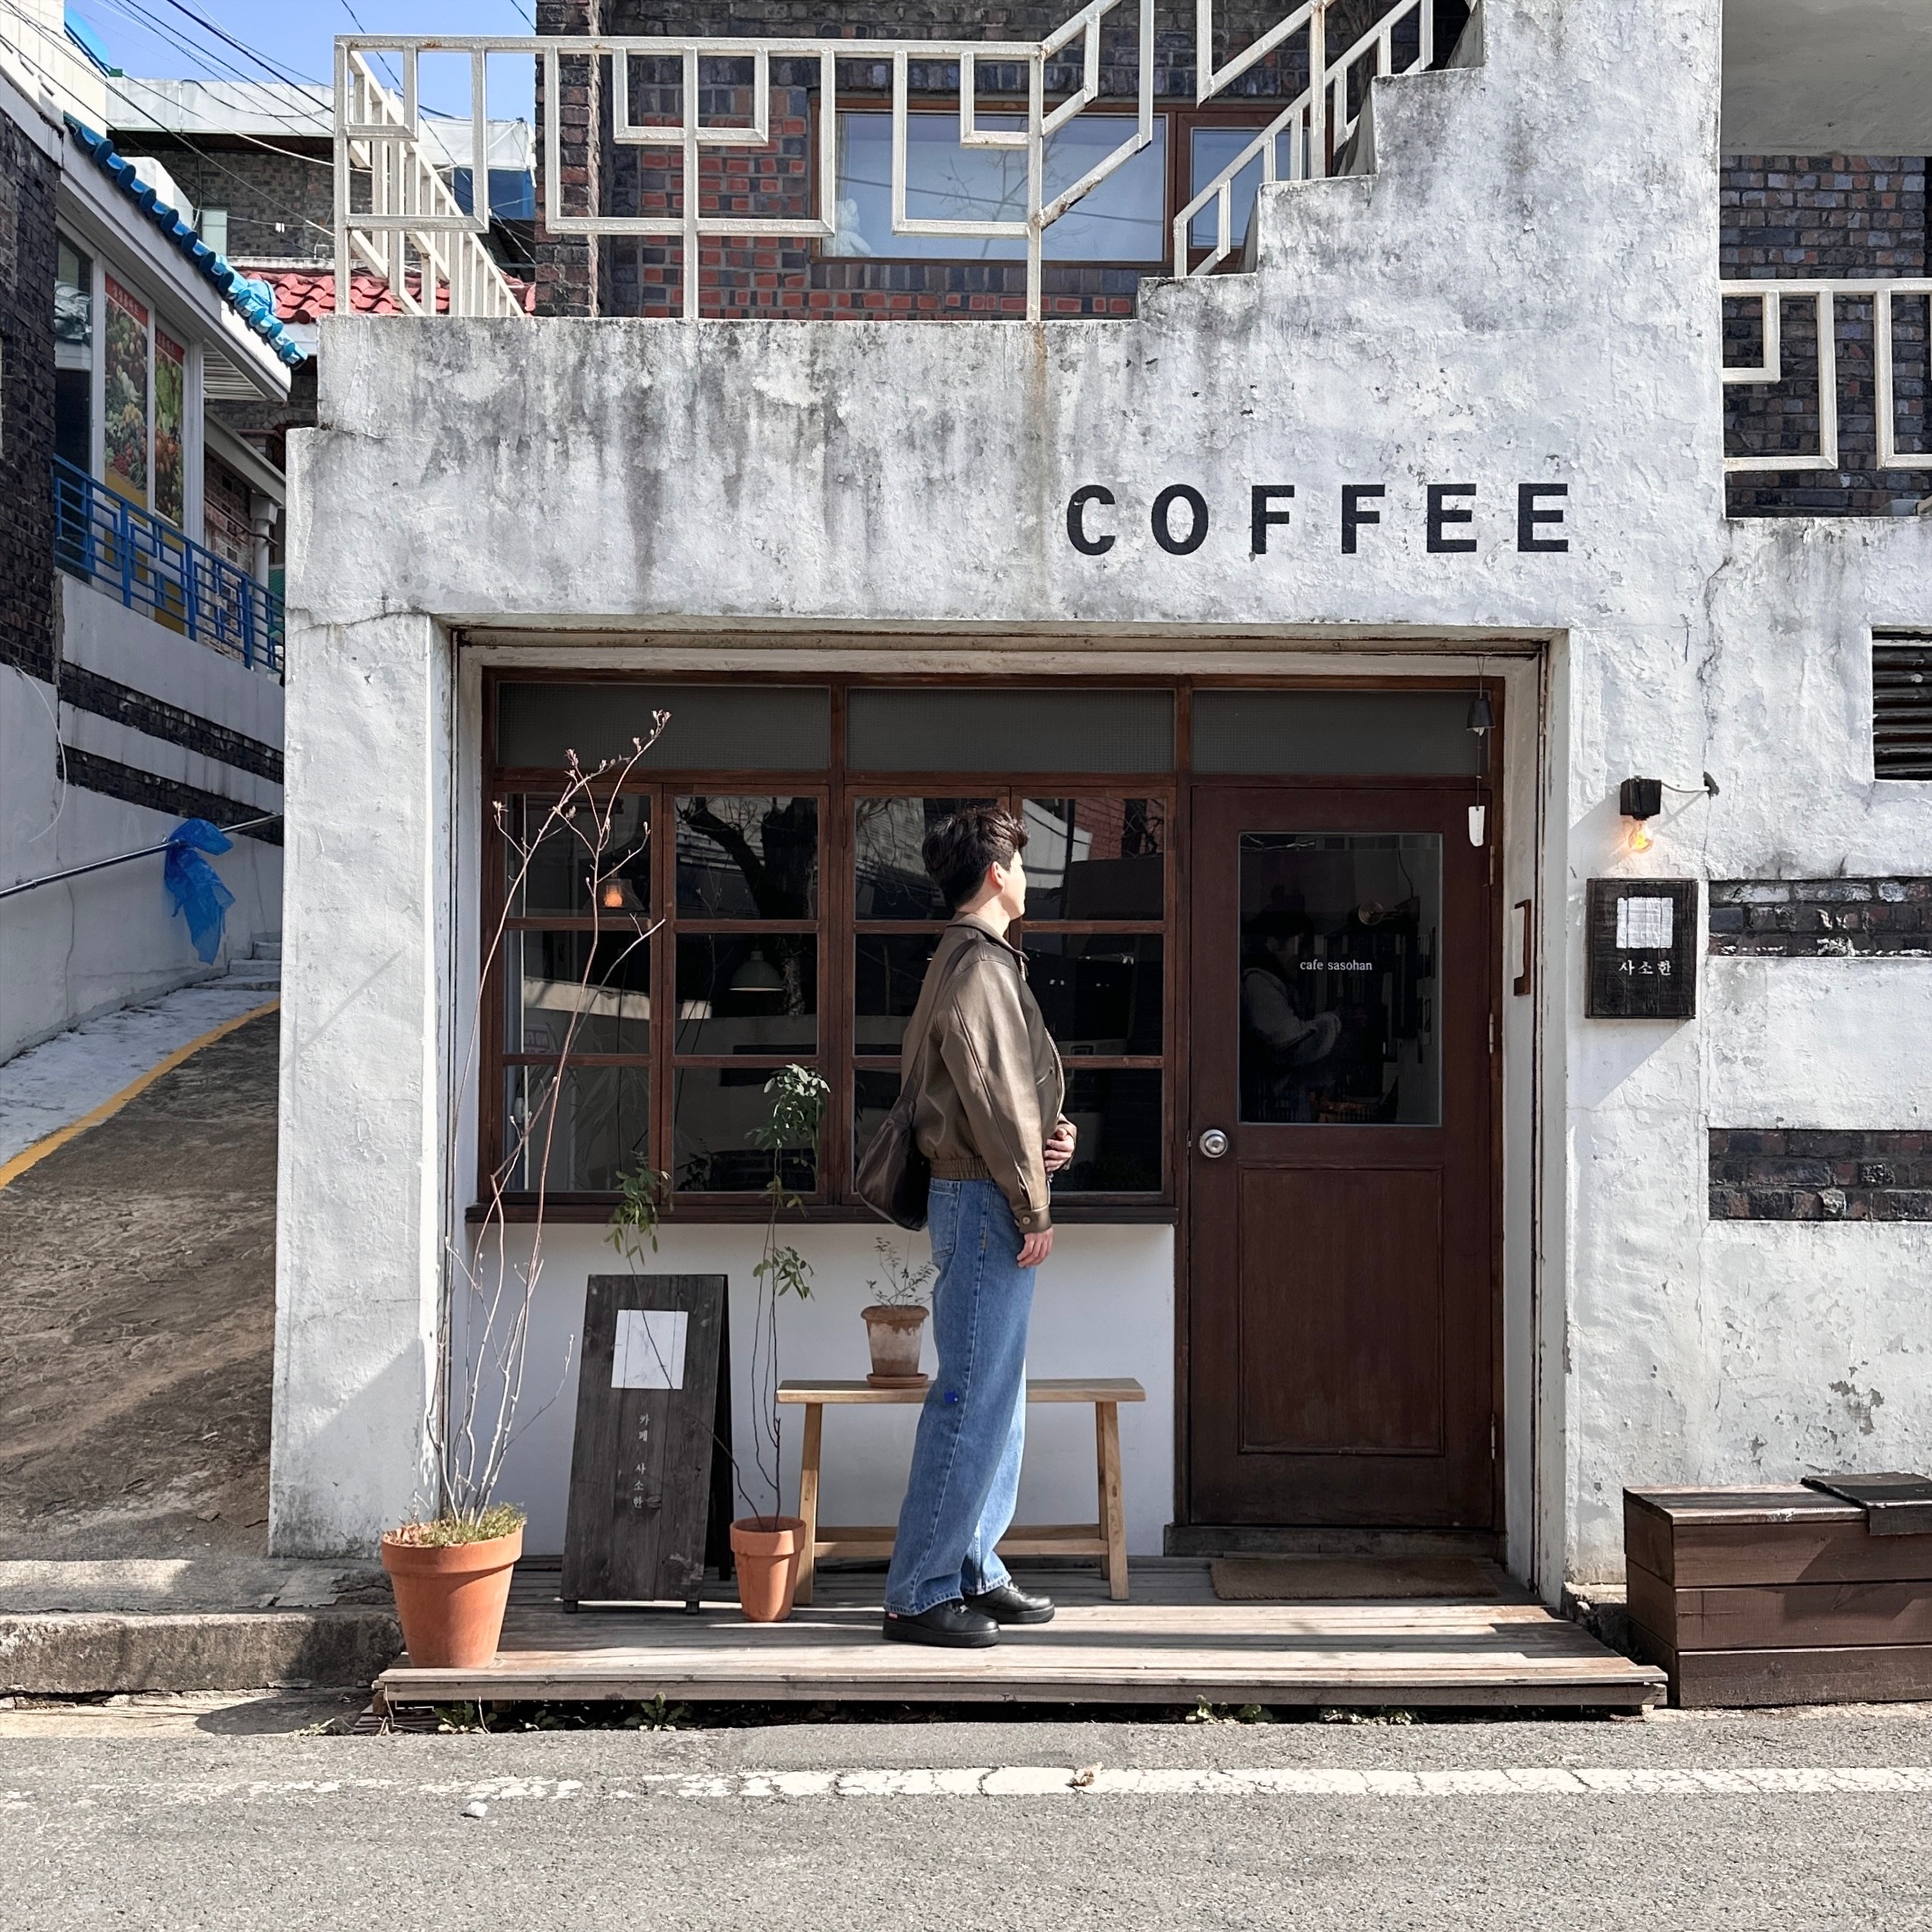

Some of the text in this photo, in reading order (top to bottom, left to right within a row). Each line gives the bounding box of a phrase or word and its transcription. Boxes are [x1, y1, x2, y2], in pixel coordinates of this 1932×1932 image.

[1066, 483, 1569, 556] COFFEE
[1299, 958, 1373, 970] cafe sasohan
[1618, 959, 1672, 976] 사소한
[633, 1413, 650, 1509] 카페 사소한
